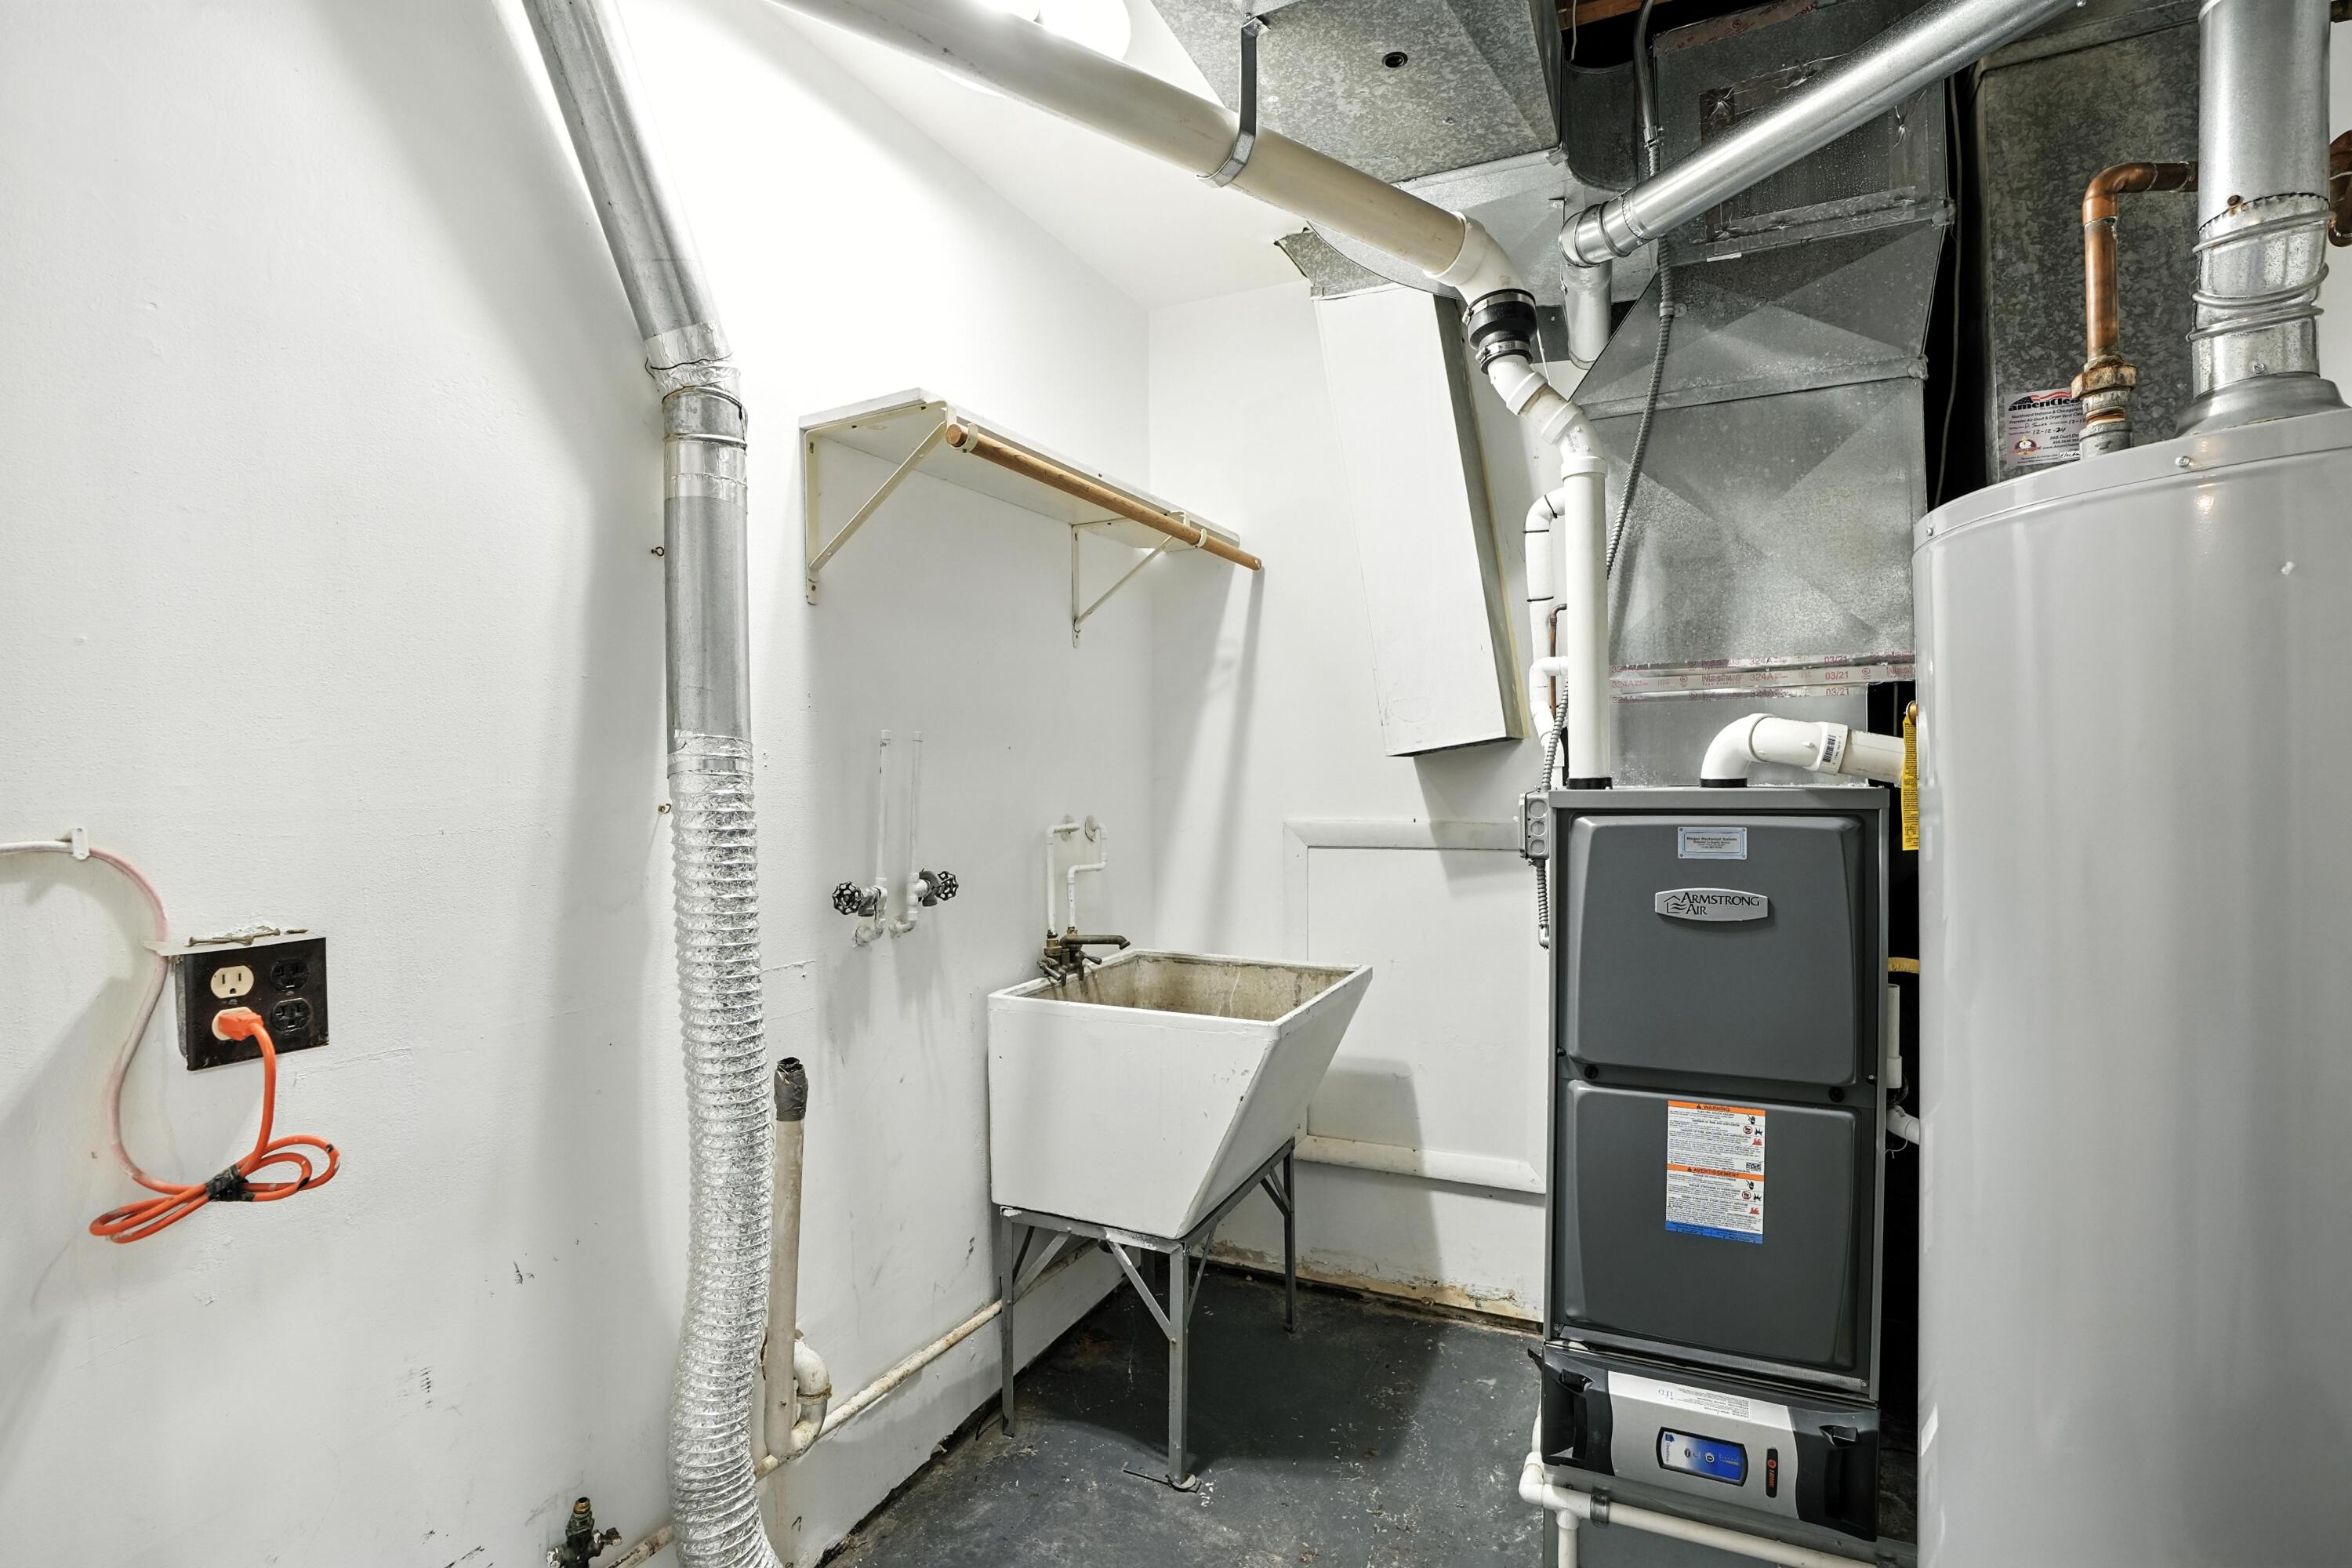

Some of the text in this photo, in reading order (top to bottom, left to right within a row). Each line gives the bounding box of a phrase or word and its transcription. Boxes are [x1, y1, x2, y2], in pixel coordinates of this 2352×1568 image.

[1824, 655, 1847, 665] 03/21
[1749, 672, 1773, 681] 324A
[1825, 670, 1849, 680] 03/21
[1826, 687, 1849, 696] 03/21
[1681, 892, 1760, 906] ARMSTRONG
[1686, 903, 1708, 915] AIR
[1693, 1167, 1740, 1178] AVERTISSEMENT
